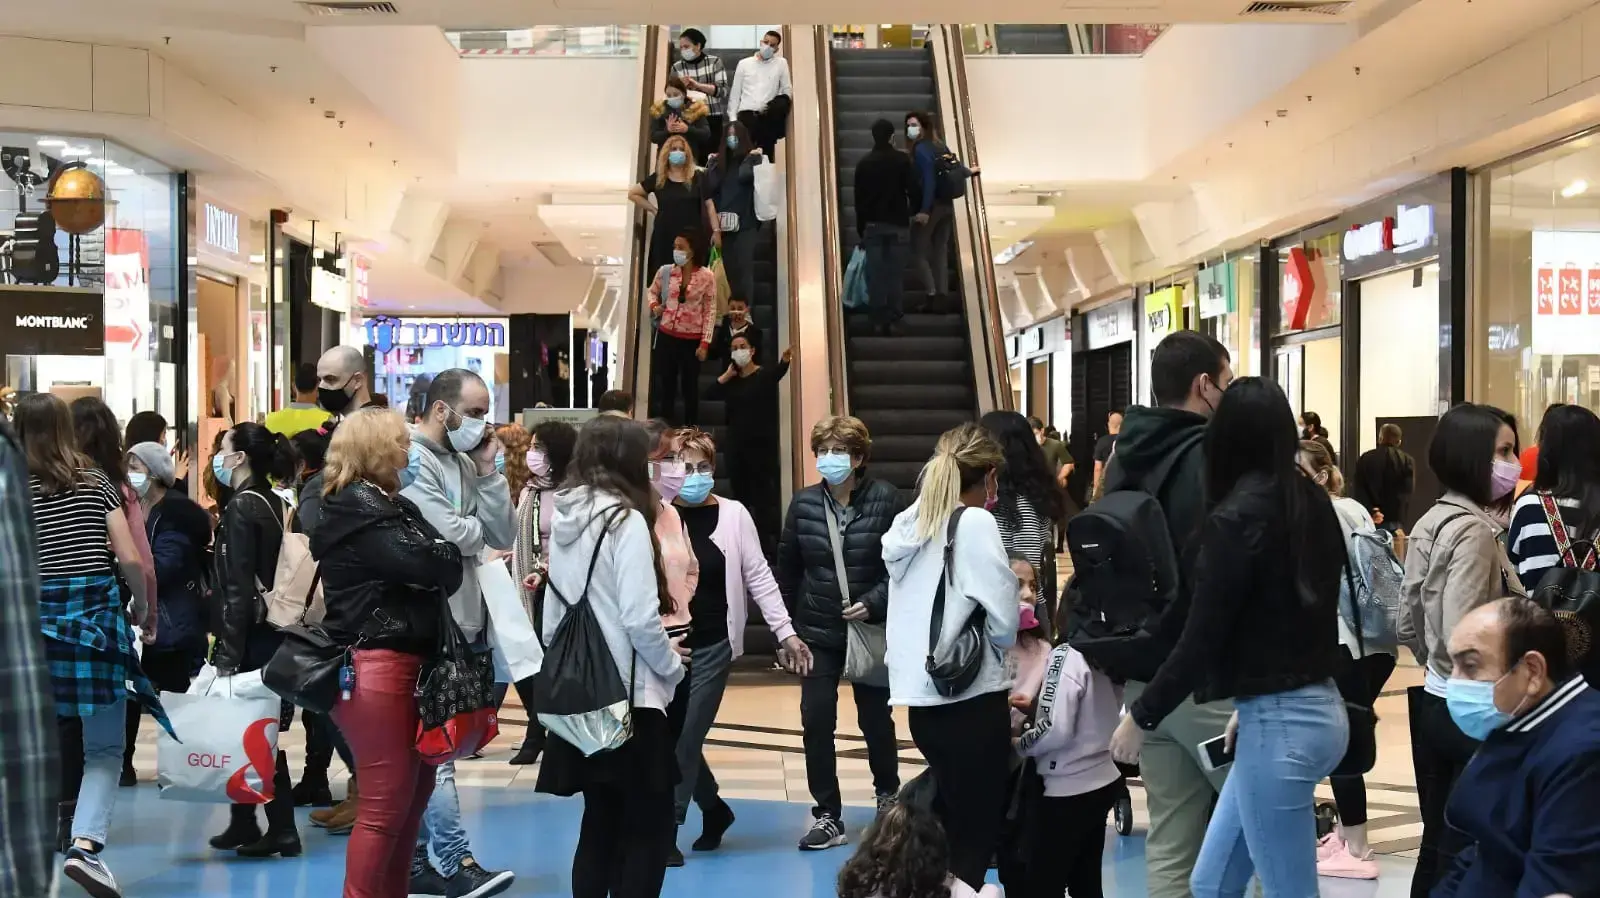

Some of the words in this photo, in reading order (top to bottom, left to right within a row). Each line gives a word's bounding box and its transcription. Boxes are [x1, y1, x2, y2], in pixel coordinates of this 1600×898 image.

[16, 315, 88, 329] MONTBLANC
[401, 322, 505, 348] המשביר
[1048, 655, 1064, 677] ARE
[1042, 682, 1057, 702] YOU
[188, 752, 232, 769] GOLF
